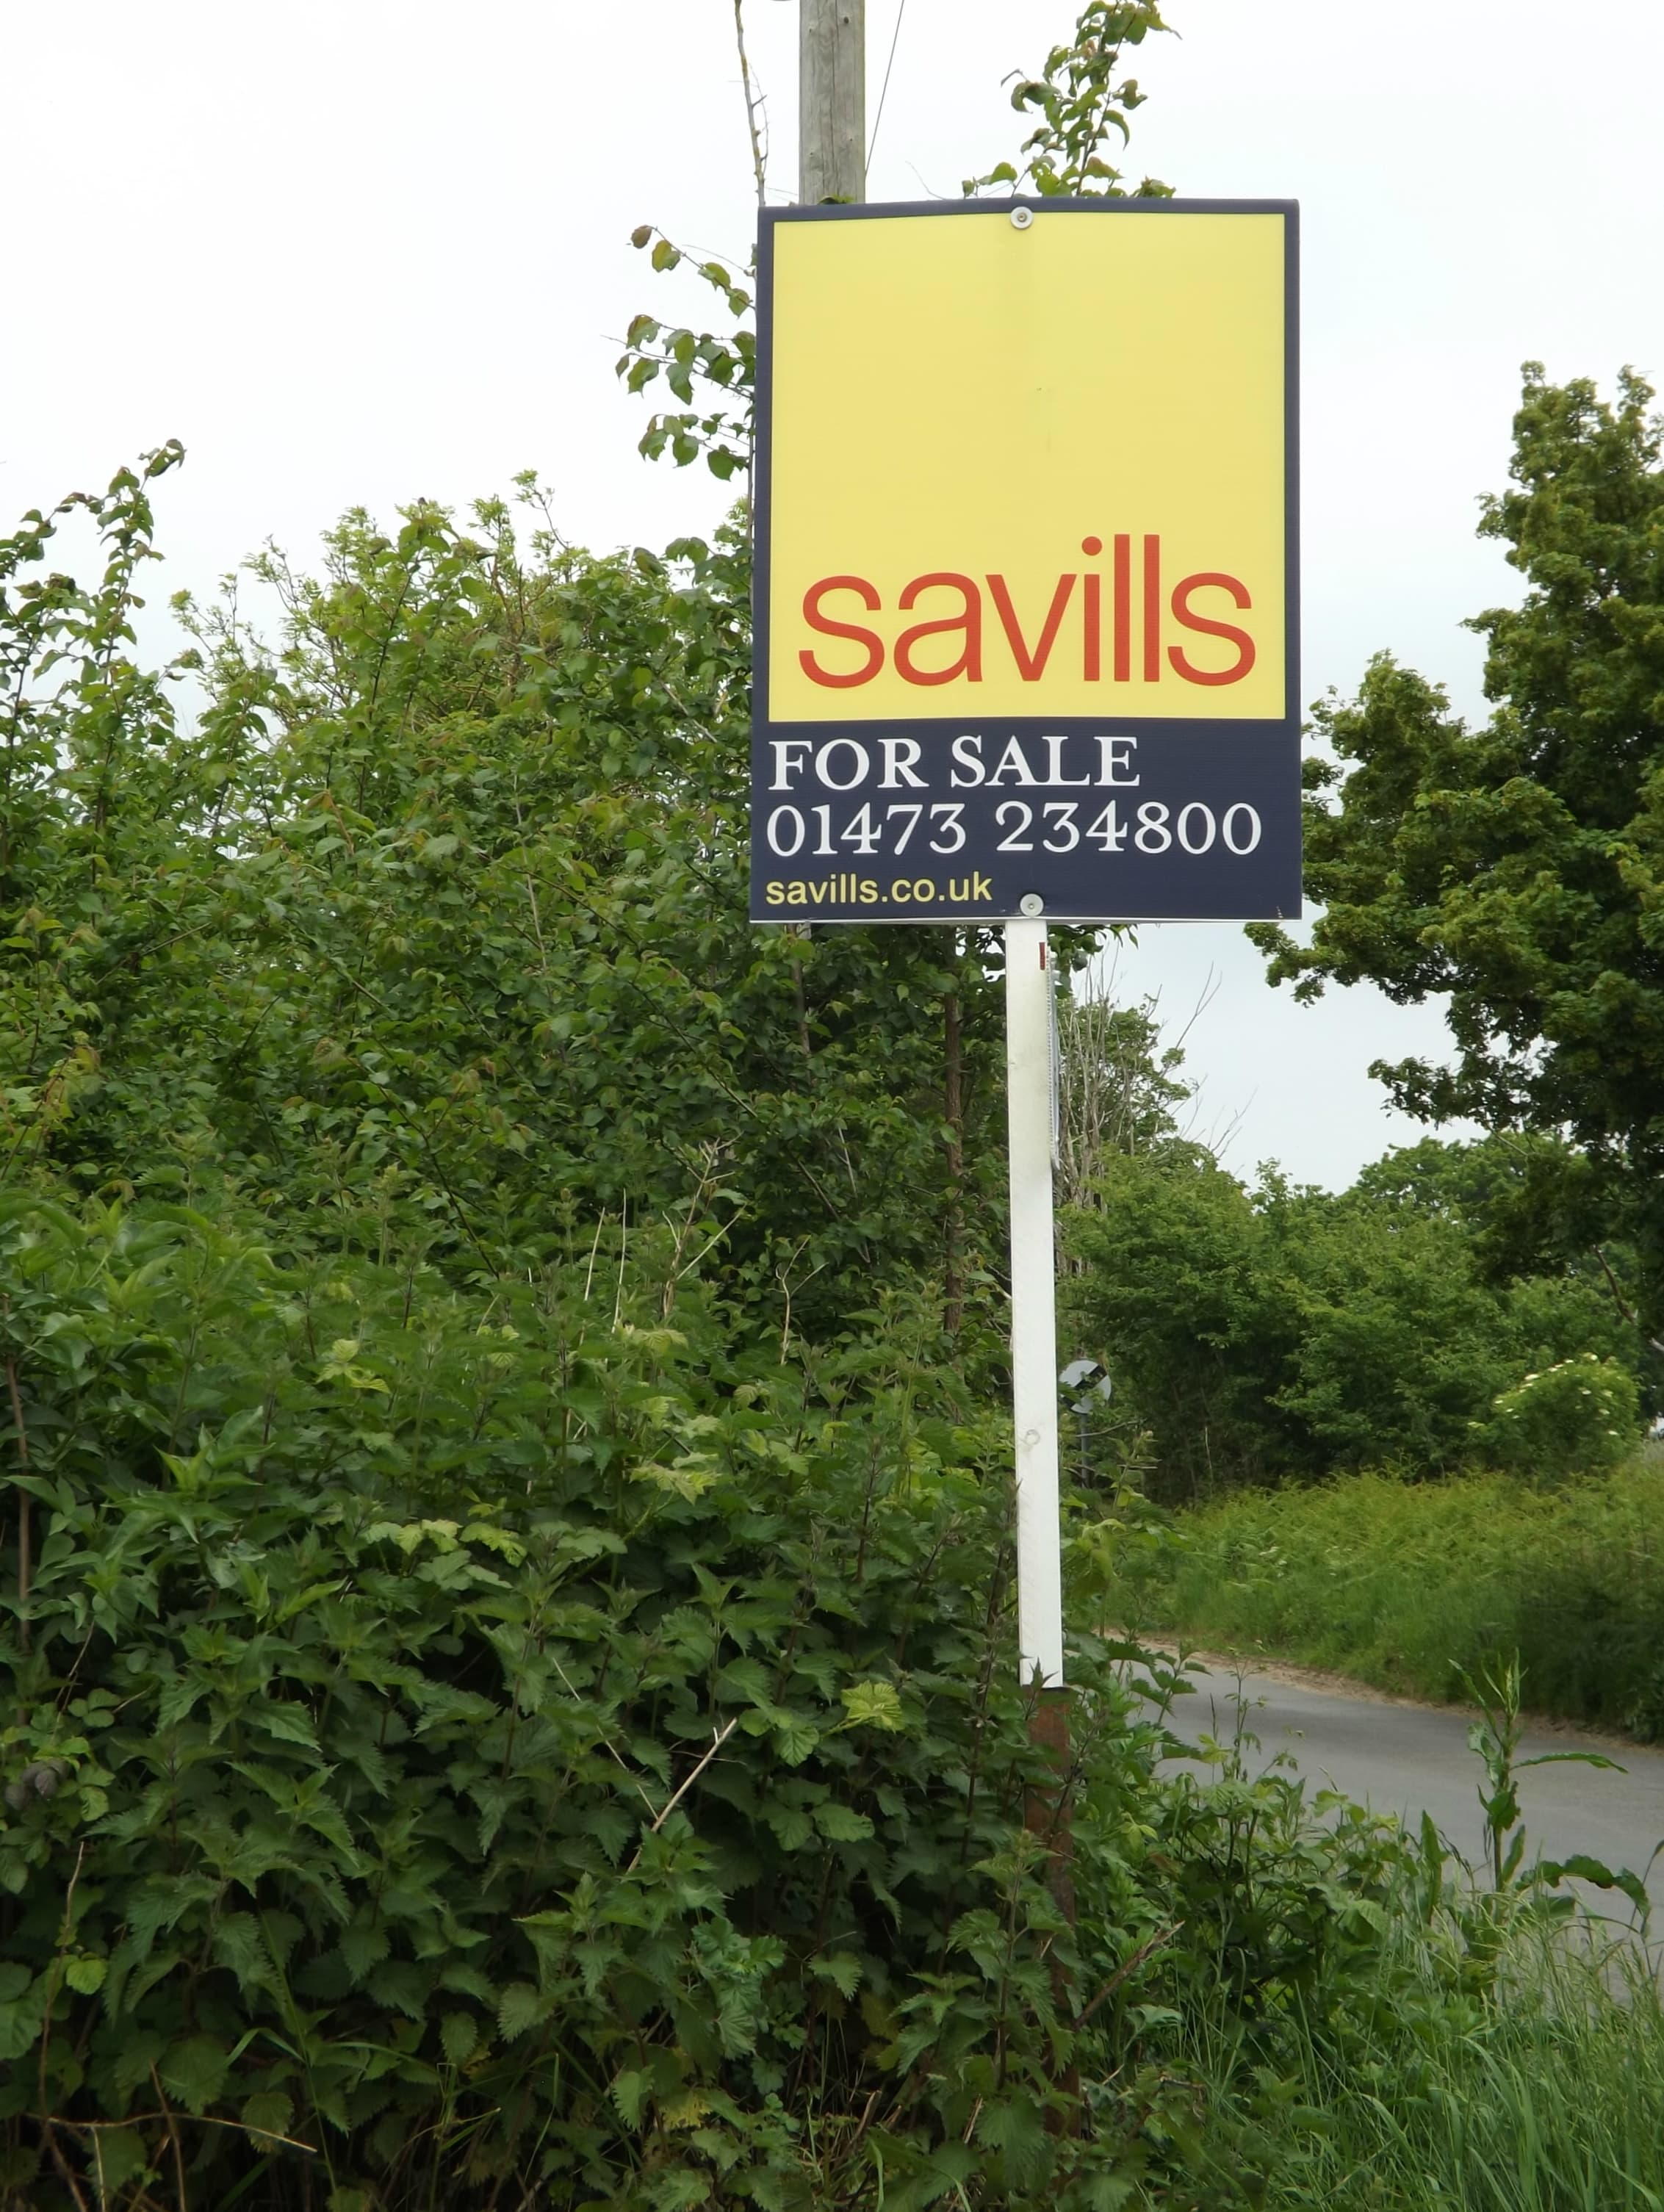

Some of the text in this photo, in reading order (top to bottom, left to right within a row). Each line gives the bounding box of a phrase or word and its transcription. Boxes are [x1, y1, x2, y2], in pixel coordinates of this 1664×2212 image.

[799, 533, 1256, 688] savills
[768, 735, 1141, 790] FOR SALE
[766, 799, 1261, 857] 01473 234800
[766, 871, 993, 905] savills.co.uk
